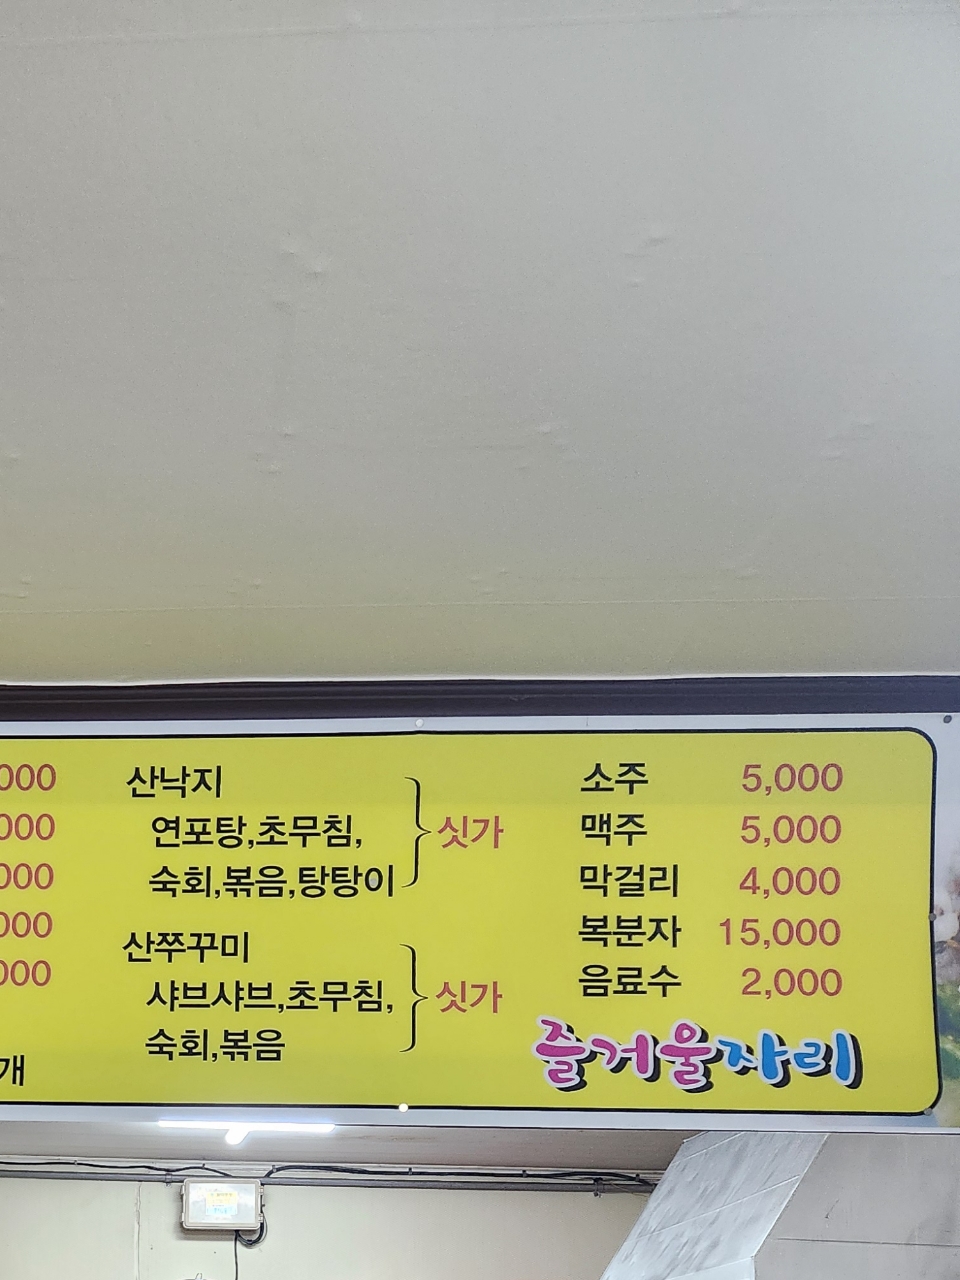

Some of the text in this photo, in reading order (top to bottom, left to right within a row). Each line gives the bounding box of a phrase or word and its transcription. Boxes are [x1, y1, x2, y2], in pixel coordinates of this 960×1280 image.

[126, 764, 223, 799] 산낙지
[580, 762, 844, 796] 소주 5,000
[151, 815, 362, 850] 연포탕,초무침,
[437, 815, 504, 849] 싯가
[581, 813, 841, 848] 맥주 5,000
[149, 864, 395, 899] 숙회,볶음,탕탕이
[580, 864, 841, 899] 막걸리 4,000
[122, 931, 250, 964] 산쭈꾸미
[578, 915, 841, 949] 복분자 15,000
[146, 980, 394, 1014] 샤브샤브,초무침,
[436, 980, 503, 1014] 싯가
[578, 965, 843, 1000] 음료수 2,000
[145, 1028, 286, 1063] 숙회,볶음
[534, 1016, 862, 1093] 즐거울자리
